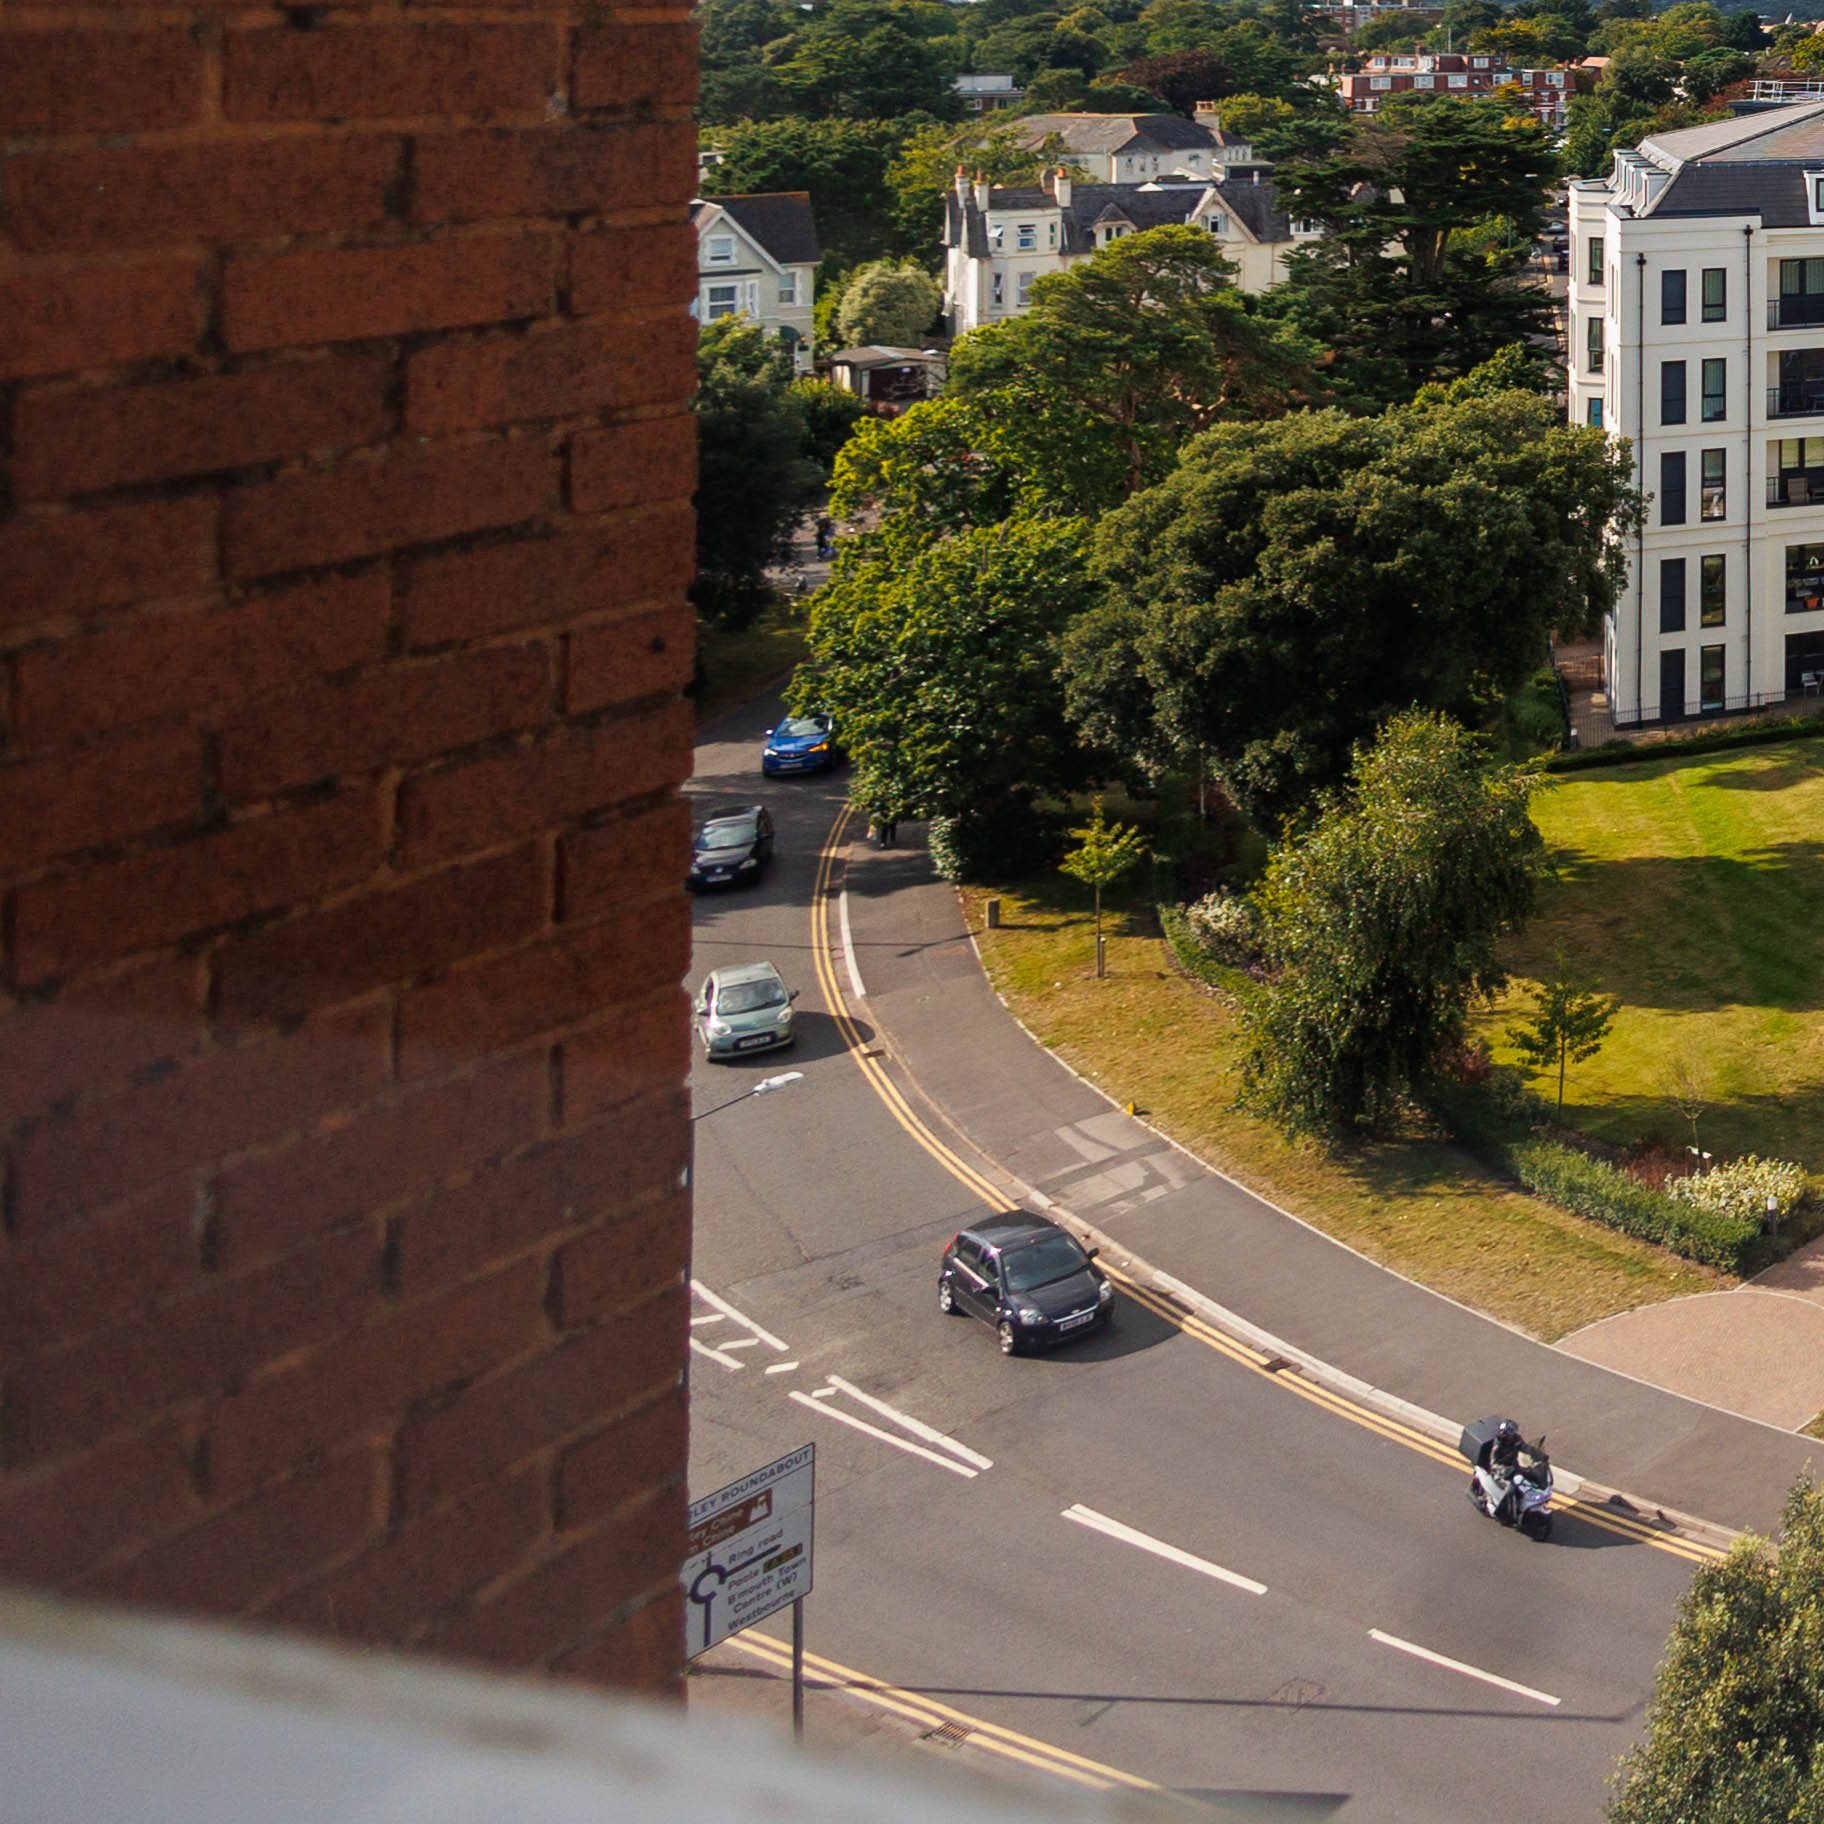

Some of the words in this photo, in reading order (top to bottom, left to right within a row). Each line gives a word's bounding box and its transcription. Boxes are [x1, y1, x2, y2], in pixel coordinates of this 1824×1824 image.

[688, 1498, 716, 1520] LEY
[721, 1450, 810, 1502] ROUNDABOUT
[729, 1546, 755, 1565] Ring
[758, 1527, 784, 1548] road
[778, 1556, 807, 1576] Town
[728, 1568, 759, 1589] Poole
[734, 1588, 772, 1613] Centre
[776, 1569, 798, 1590] (W)
[727, 1589, 795, 1631] Westbourne
